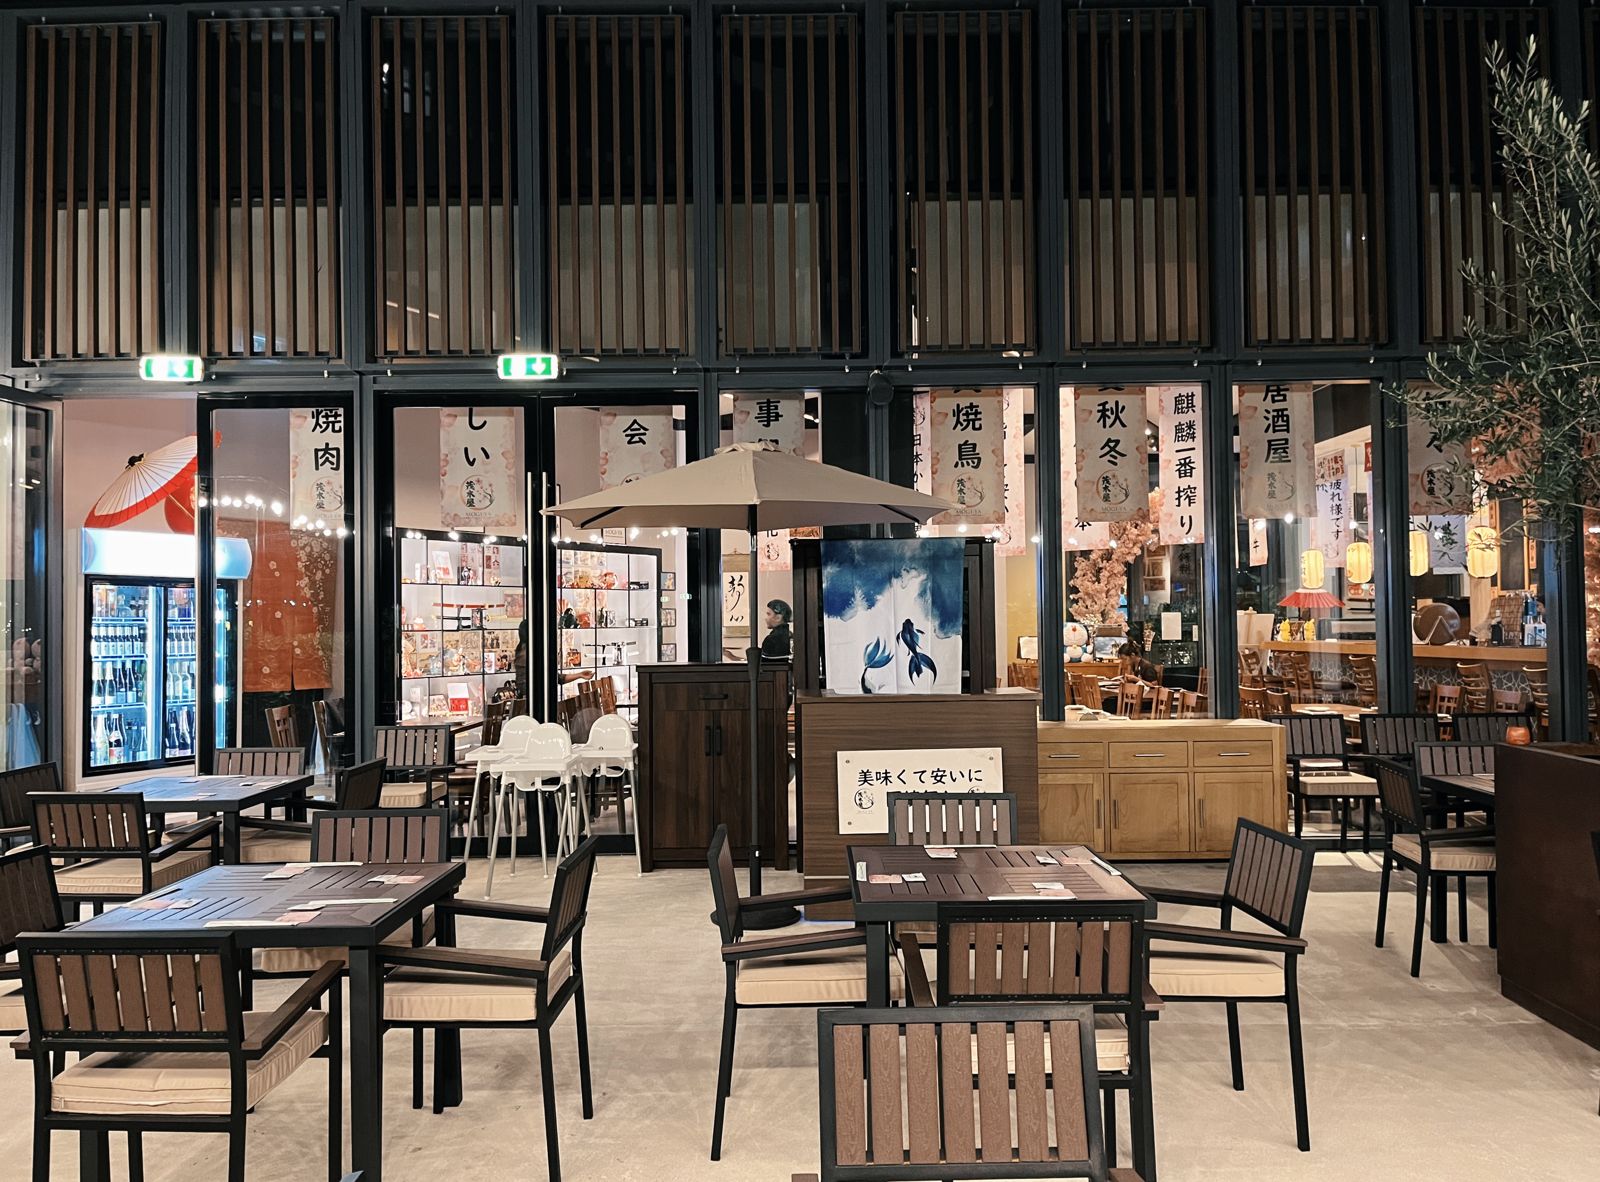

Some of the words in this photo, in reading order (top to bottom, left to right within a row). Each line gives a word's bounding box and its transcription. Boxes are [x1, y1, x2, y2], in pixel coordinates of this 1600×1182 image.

[311, 408, 342, 471] 焼肉
[463, 407, 490, 467] しい
[622, 419, 649, 446] 会
[754, 398, 783, 447] 事
[952, 387, 983, 469] 焼鳥
[1096, 386, 1128, 466] 秋冬
[1263, 385, 1291, 464] 居酒屋
[1173, 392, 1198, 535] 麒麟一番搾り
[858, 767, 983, 787] 美味くて安いに
